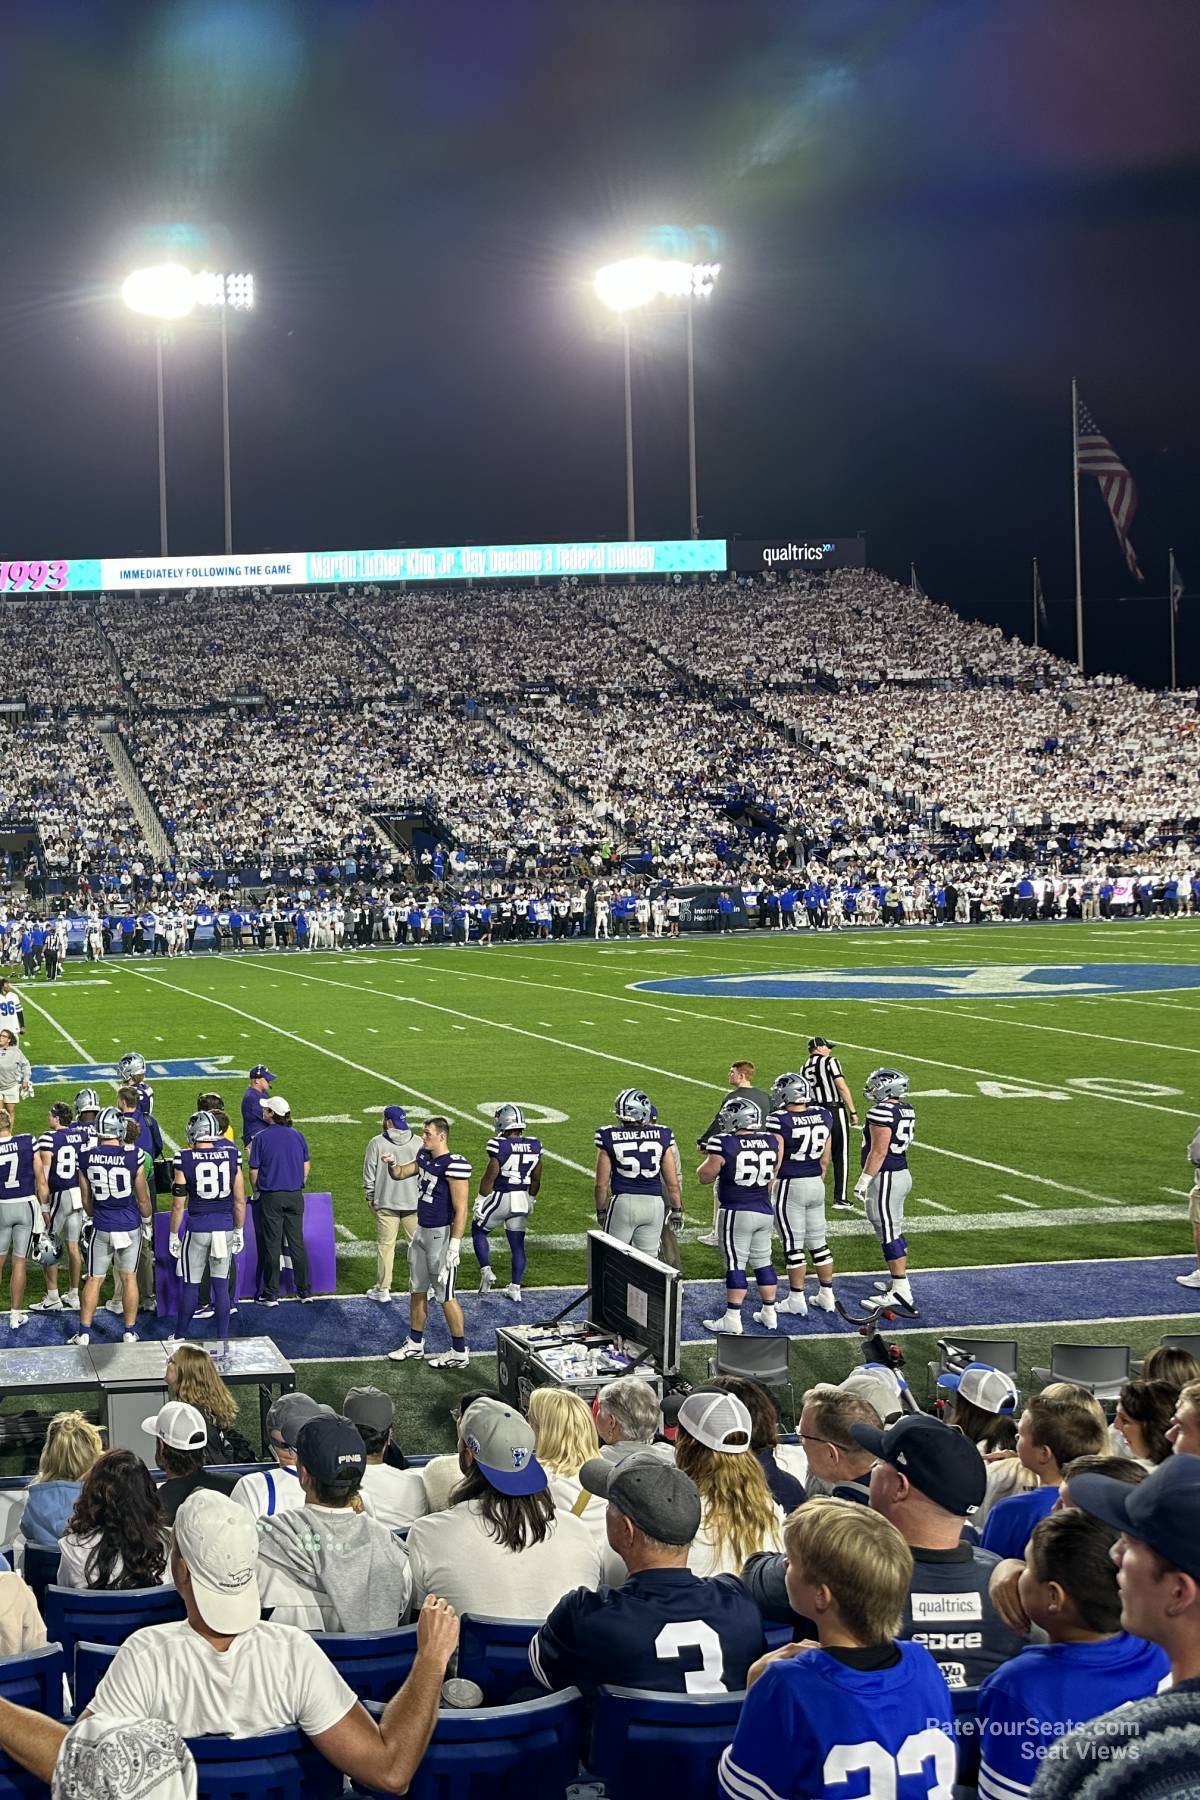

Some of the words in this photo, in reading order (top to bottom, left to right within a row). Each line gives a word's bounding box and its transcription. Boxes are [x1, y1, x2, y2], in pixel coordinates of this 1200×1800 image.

[311, 554, 357, 579] Martin
[360, 552, 402, 577] Luther
[407, 551, 435, 577] King
[490, 548, 542, 571] became
[557, 546, 605, 570] federal
[608, 545, 655, 571] holiday
[763, 543, 823, 566] qualtrics
[120, 568, 184, 580] IMMEDIATELY
[186, 566, 241, 578] FOLLOWING
[244, 565, 262, 576] THE
[265, 564, 292, 575] GAME
[694, 914, 715, 922] Health
[0, 1000, 15, 1016] 96
[804, 1066, 818, 1084] S
[792, 1114, 824, 1126] PASTORE
[611, 1130, 660, 1141] BEQUEAITH
[790, 1125, 831, 1161] 78
[511, 1143, 532, 1153] WHITE
[740, 1138, 769, 1150] CAPRIA
[89, 1154, 126, 1166] ANCIAUX
[192, 1151, 229, 1160] METZGER
[612, 1141, 663, 1179] 53
[501, 1154, 540, 1185] 47
[734, 1151, 777, 1187] 66
[195, 1161, 231, 1199] 81
[338, 1454, 362, 1464] PING
